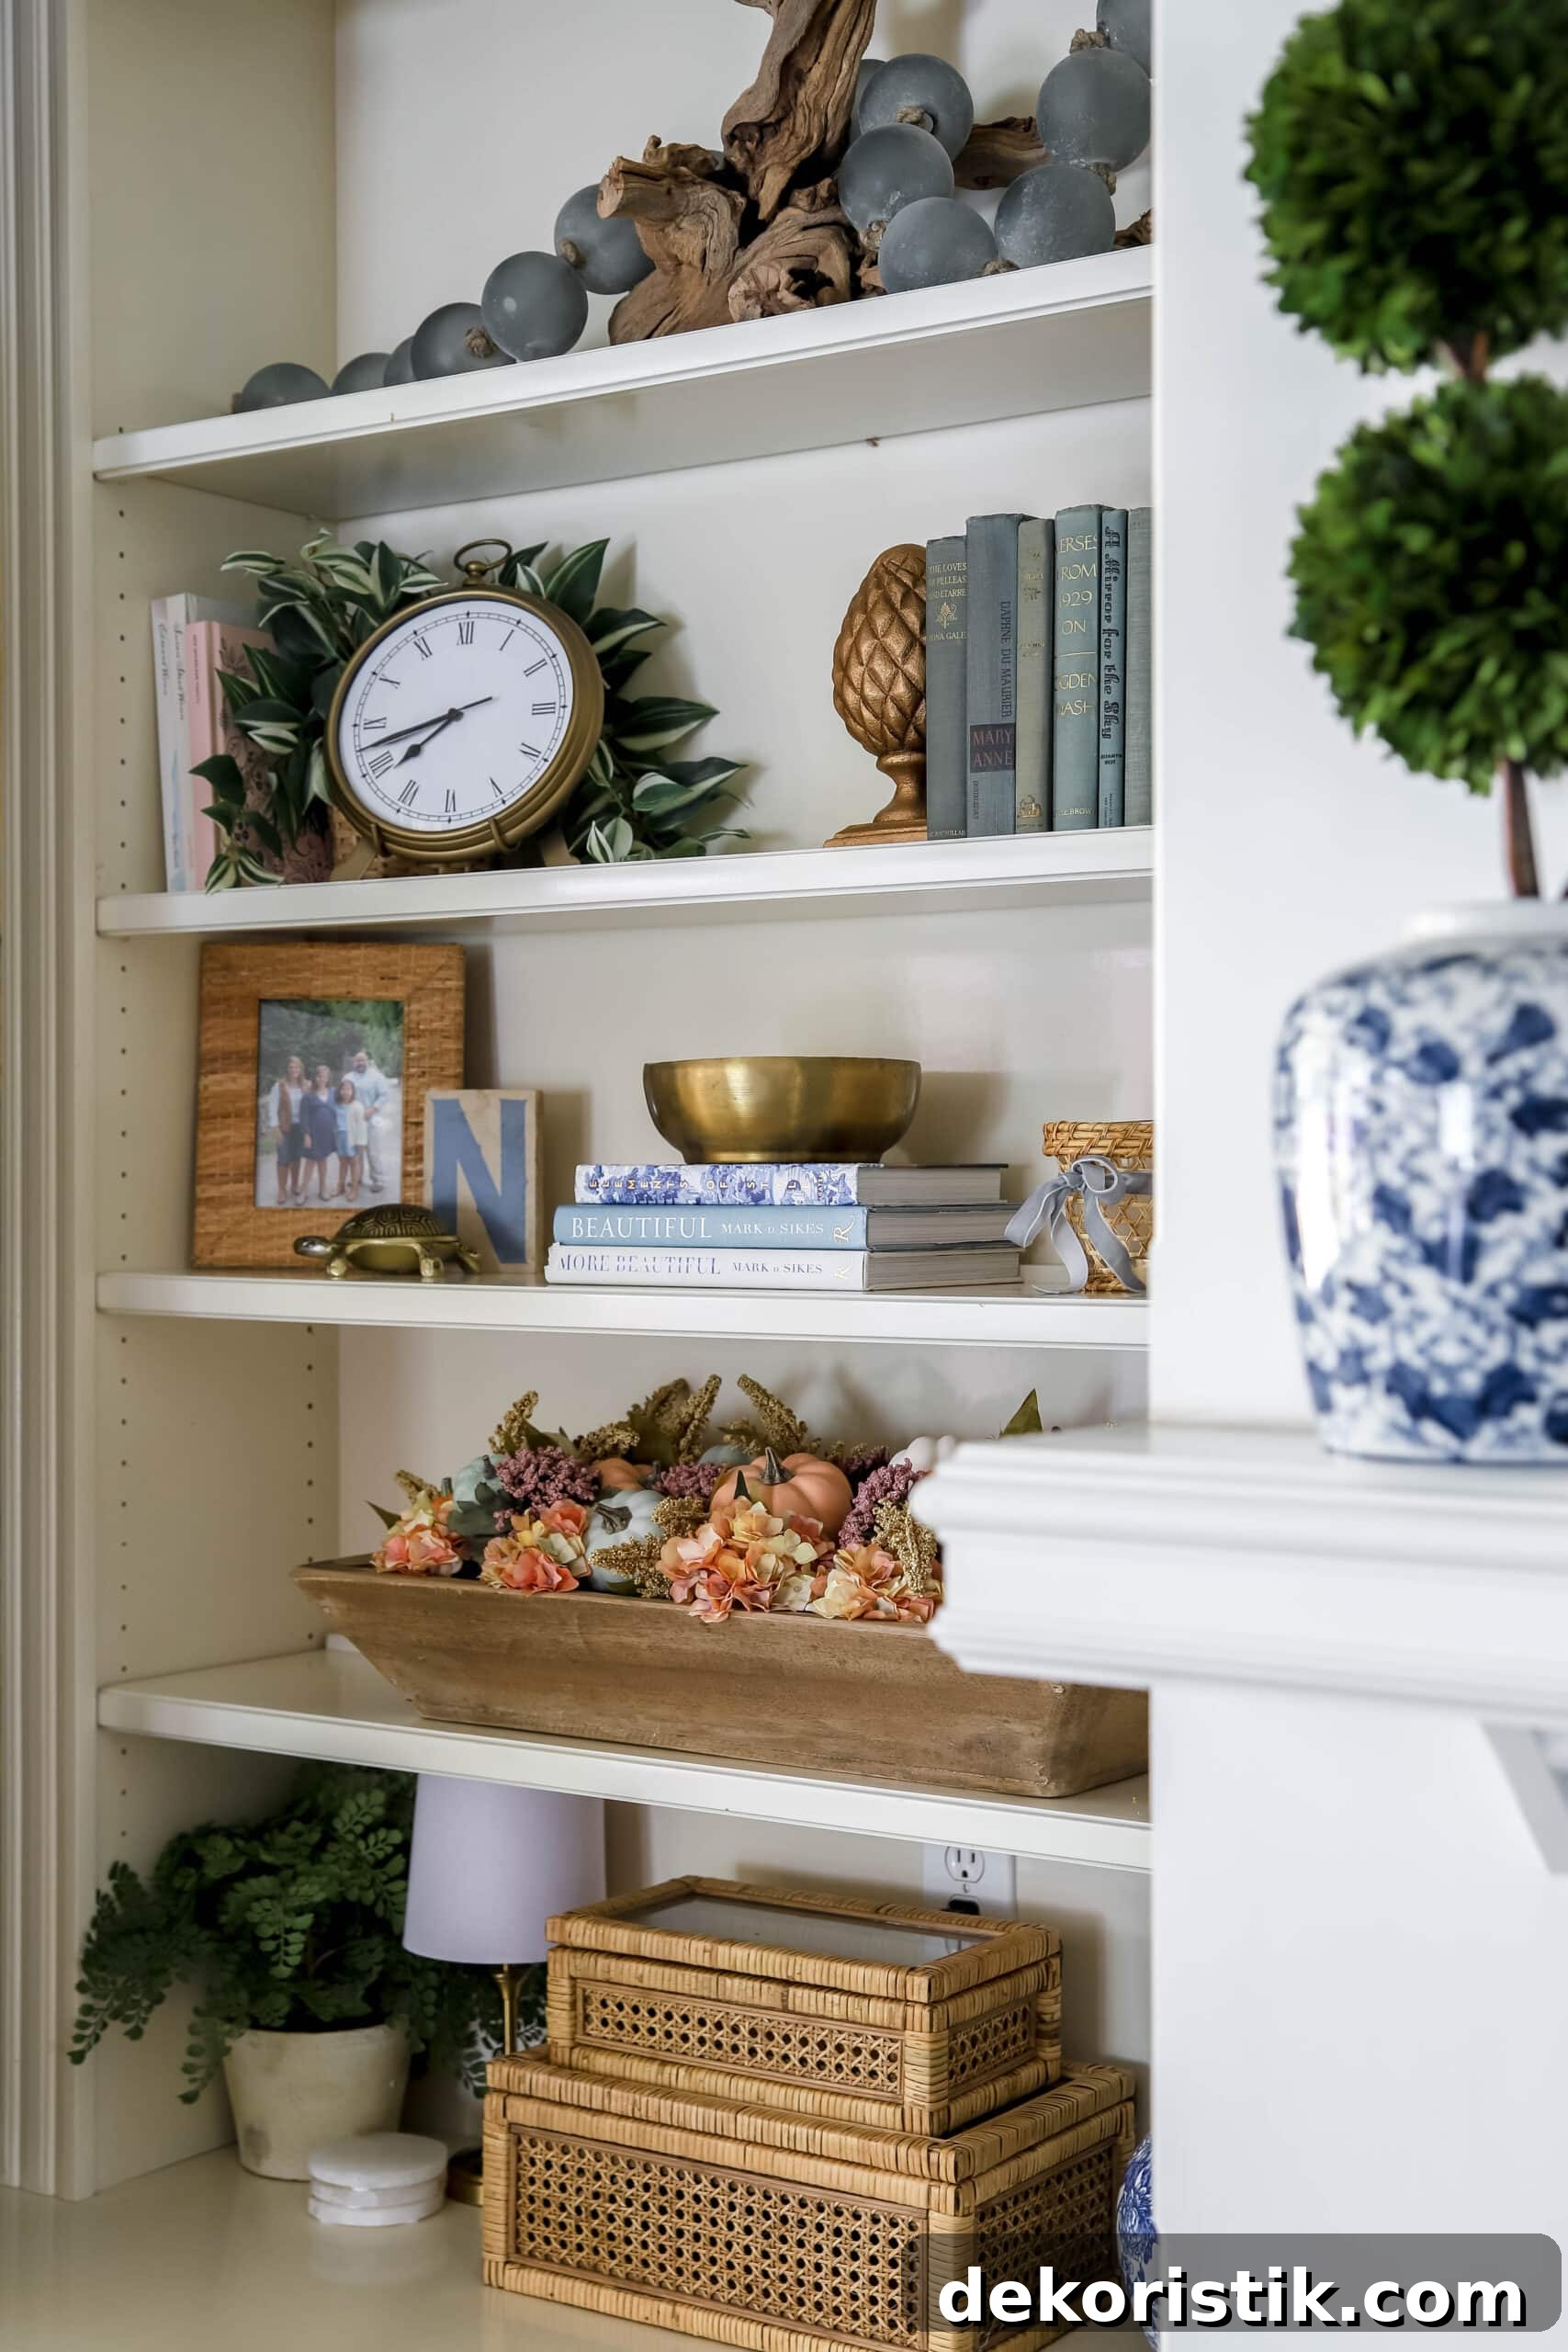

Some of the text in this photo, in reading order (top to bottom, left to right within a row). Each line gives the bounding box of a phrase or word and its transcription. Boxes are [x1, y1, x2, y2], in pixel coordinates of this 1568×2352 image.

[1058, 535, 1098, 554] ERSES
[942, 562, 967, 572] LOVES
[1060, 562, 1098, 581] ROM
[999, 601, 1011, 643] DAPHNE
[1061, 618, 1086, 634] ON
[457, 621, 474, 646] XII
[1102, 628, 1119, 659] for
[1058, 673, 1096, 691] GDEN
[1104, 664, 1120, 695] the
[974, 729, 1011, 745] MARY
[975, 751, 1013, 767] ANNE
[431, 1098, 528, 1263] N
[746, 1180, 810, 1191] STLE
[572, 1216, 712, 1238] BEAUTIFUL
[721, 1223, 763, 1235] MARK
[780, 1223, 824, 1235] SIKES
[558, 1253, 610, 1272] MORE
[616, 1255, 721, 1275] BEAUTIFUL
[732, 1261, 770, 1272] MARK
[782, 1263, 823, 1274] SIKES
